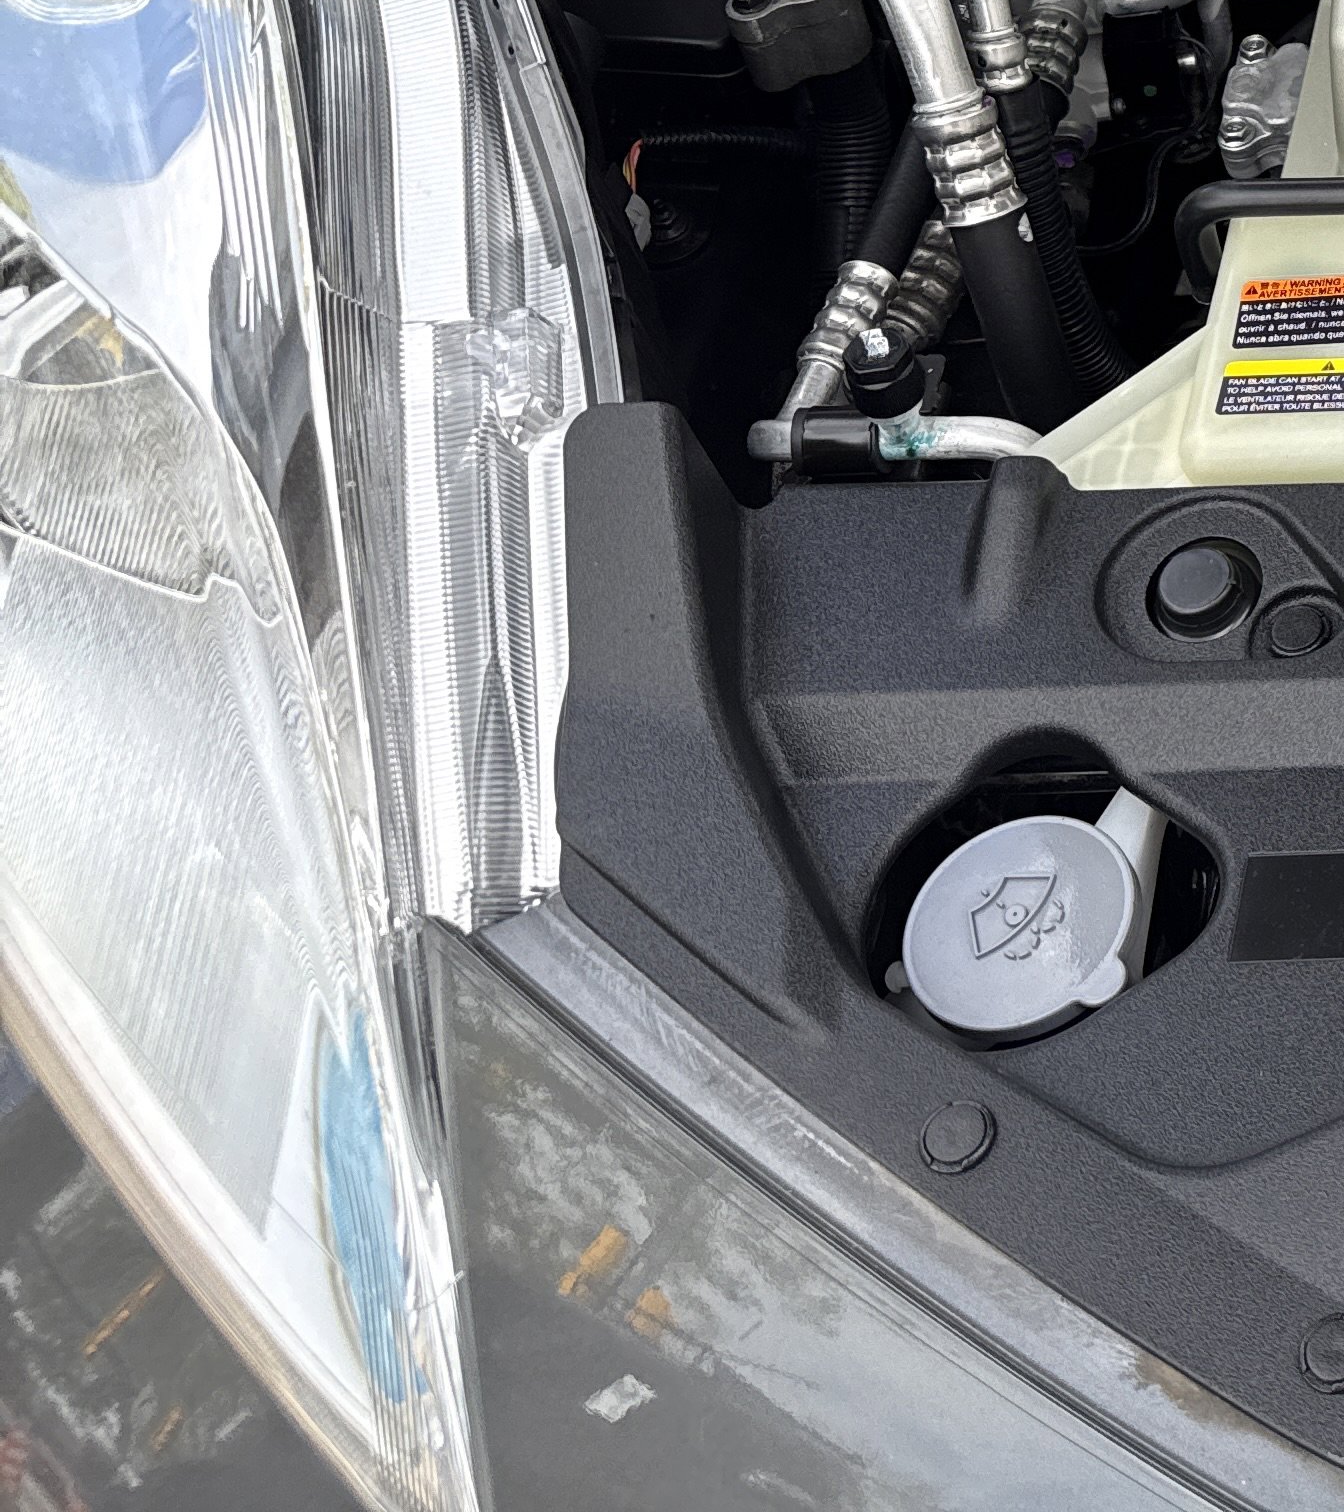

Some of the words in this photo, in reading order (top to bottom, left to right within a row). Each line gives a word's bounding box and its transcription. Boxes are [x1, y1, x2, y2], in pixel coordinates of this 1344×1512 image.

[1289, 278, 1341, 288] WARNING
[1236, 335, 1266, 345] Nunca
[1267, 334, 1289, 343] abra
[1290, 332, 1325, 343] quando
[1265, 385, 1293, 393] AVOID
[1295, 384, 1342, 392] PERSONAL
